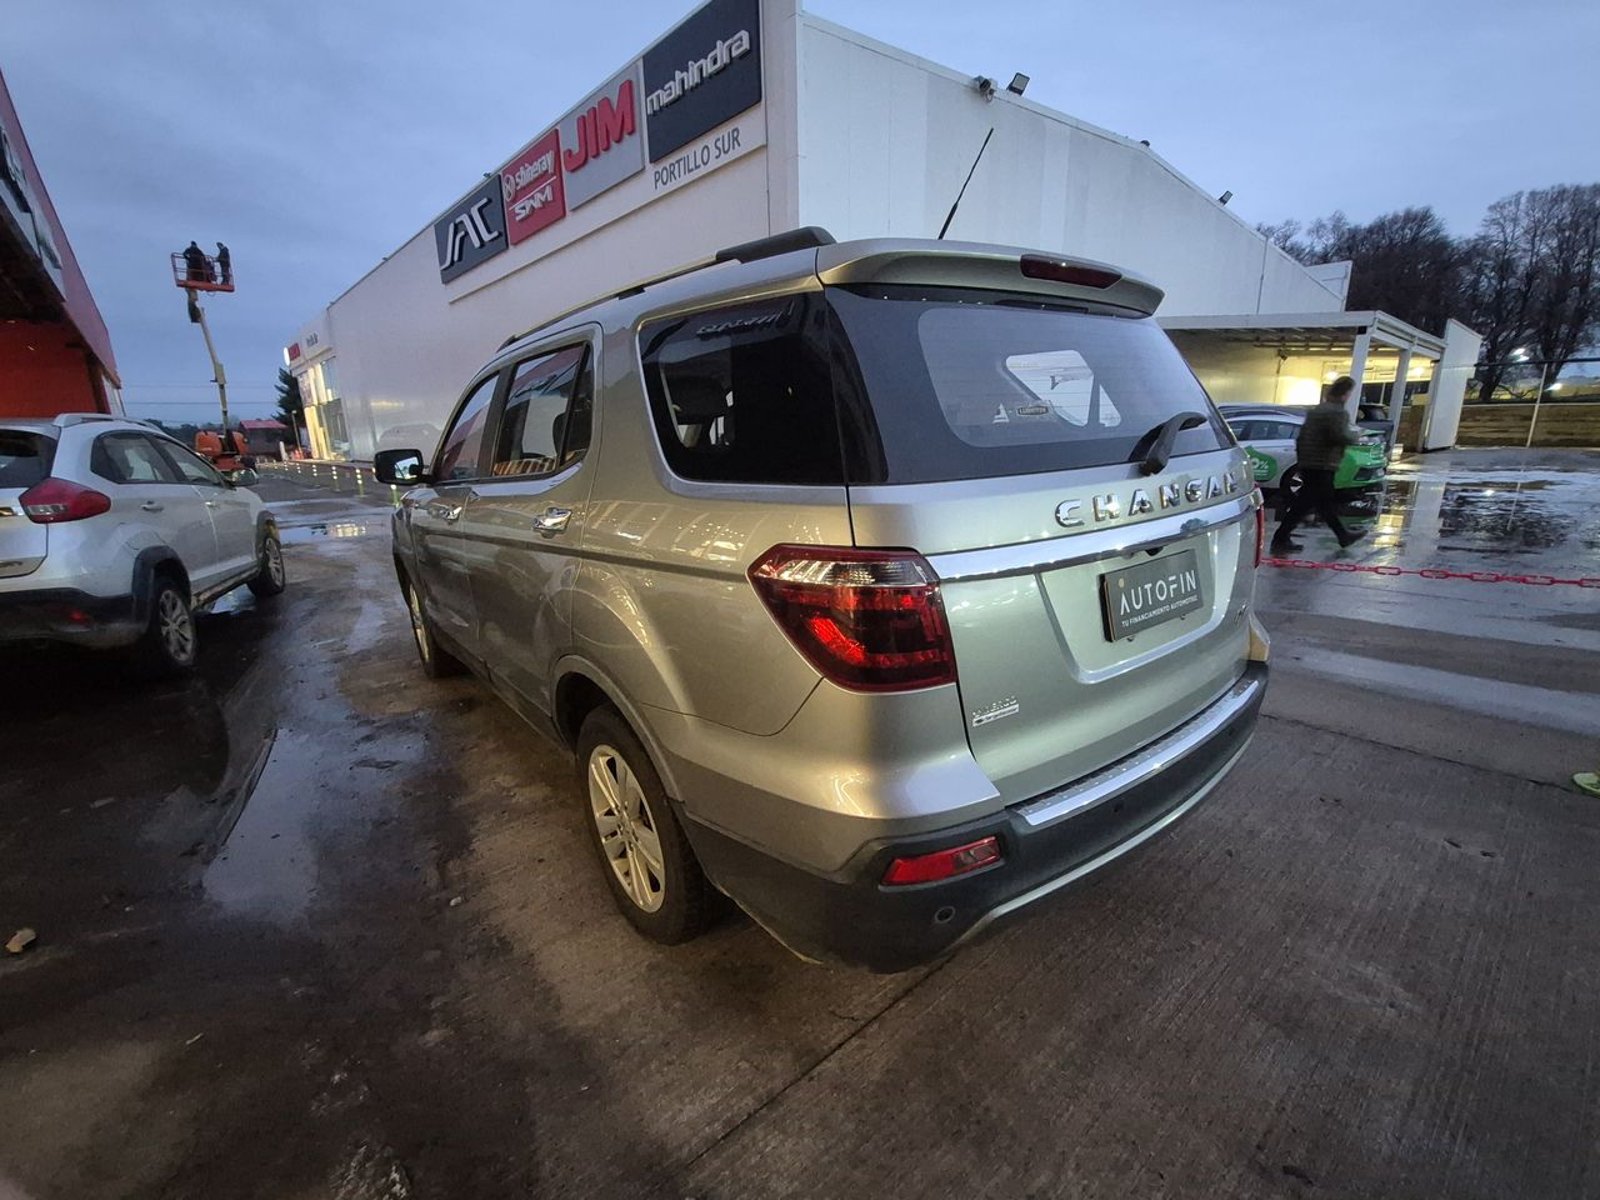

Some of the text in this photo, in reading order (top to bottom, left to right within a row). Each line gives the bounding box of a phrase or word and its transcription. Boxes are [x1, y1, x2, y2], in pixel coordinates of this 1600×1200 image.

[647, 29, 751, 115] mahindra
[563, 79, 636, 173] JIM
[654, 126, 741, 190] PORTILLO SUR
[440, 197, 500, 271] JAC
[1055, 471, 1239, 527] CHANGAN
[1120, 569, 1197, 616] AUTOFIN
